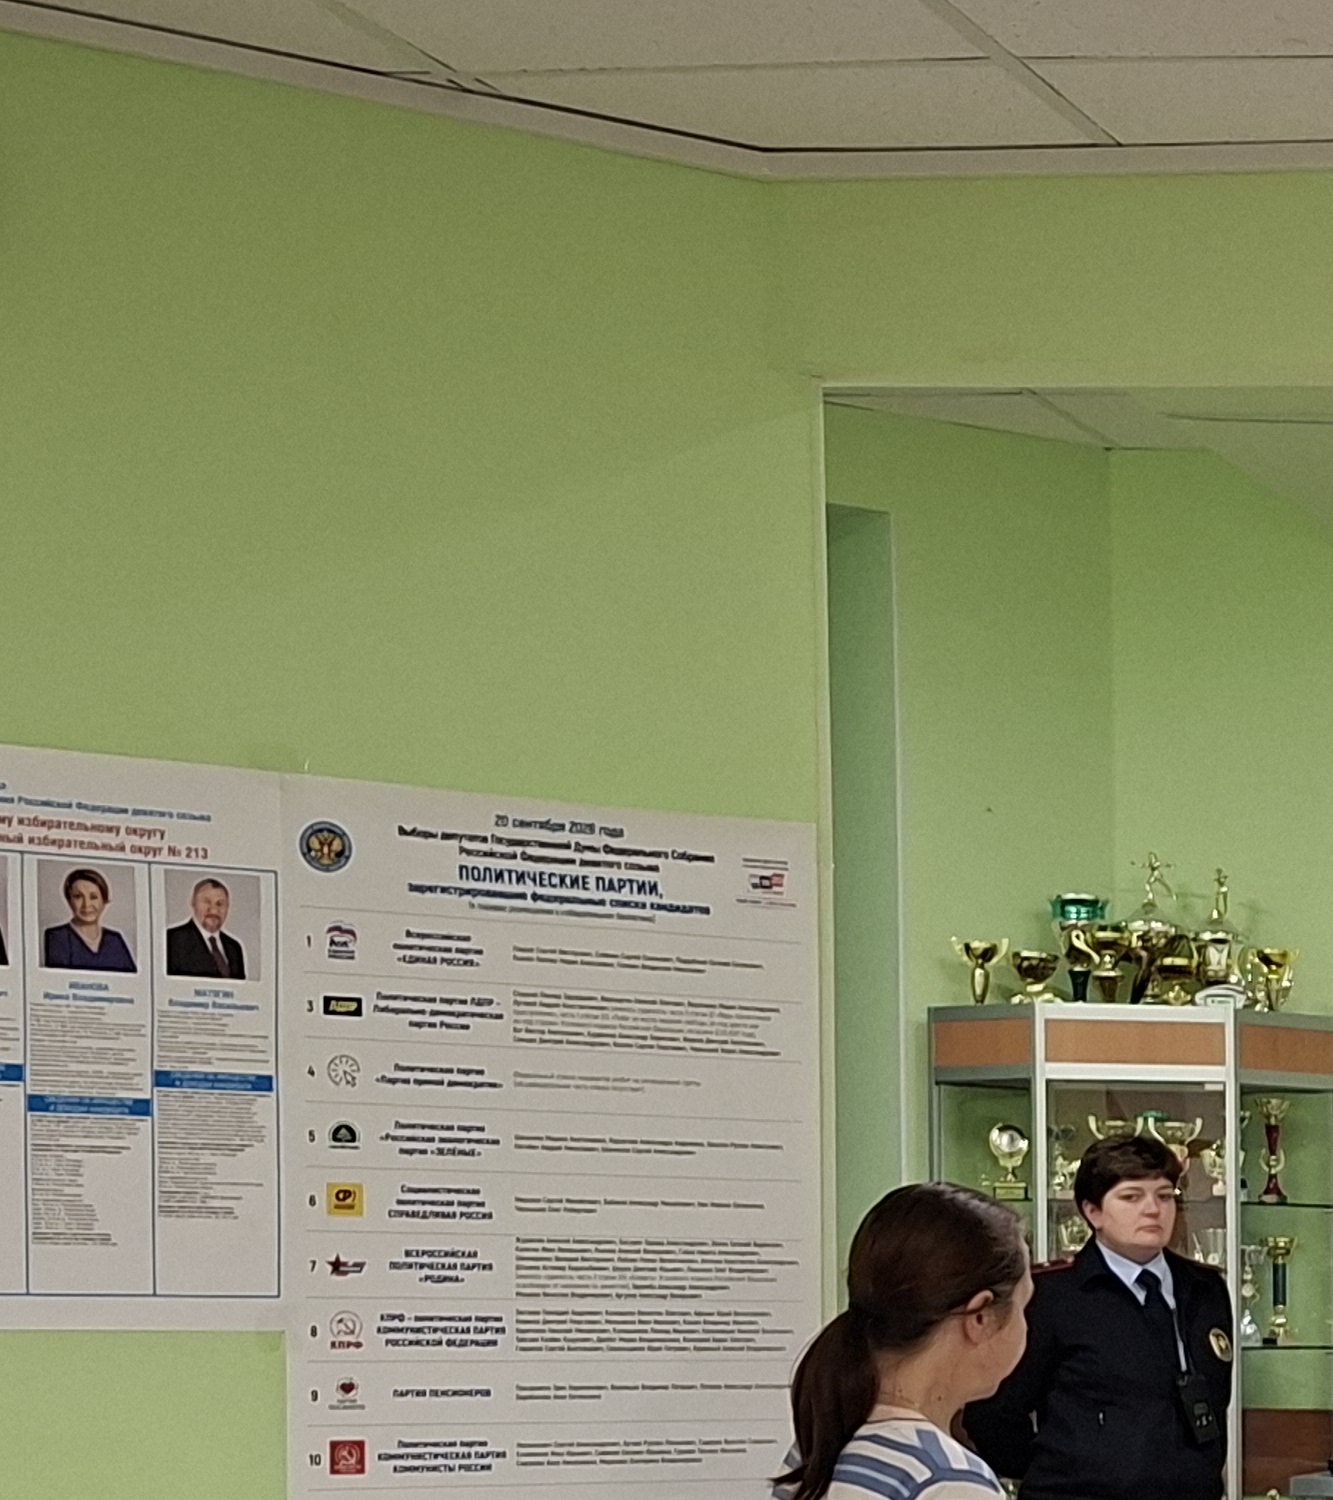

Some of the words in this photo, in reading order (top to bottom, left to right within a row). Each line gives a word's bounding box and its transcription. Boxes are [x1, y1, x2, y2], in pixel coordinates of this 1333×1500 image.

[17, 815, 120, 837] избирательному
[125, 825, 166, 841] округу
[28, 835, 126, 853] избирательный
[130, 843, 163, 858] округ
[186, 847, 209, 859] 213
[459, 864, 590, 891] ПОЛИТИЧЕСКИЕ
[595, 876, 663, 899] ПАРТИИ,
[307, 935, 312, 948] 1
[307, 1065, 316, 1077] 4
[308, 1129, 316, 1143] 5
[309, 1260, 317, 1272] 7
[310, 1389, 319, 1402] 9
[309, 1454, 322, 1467] 10
